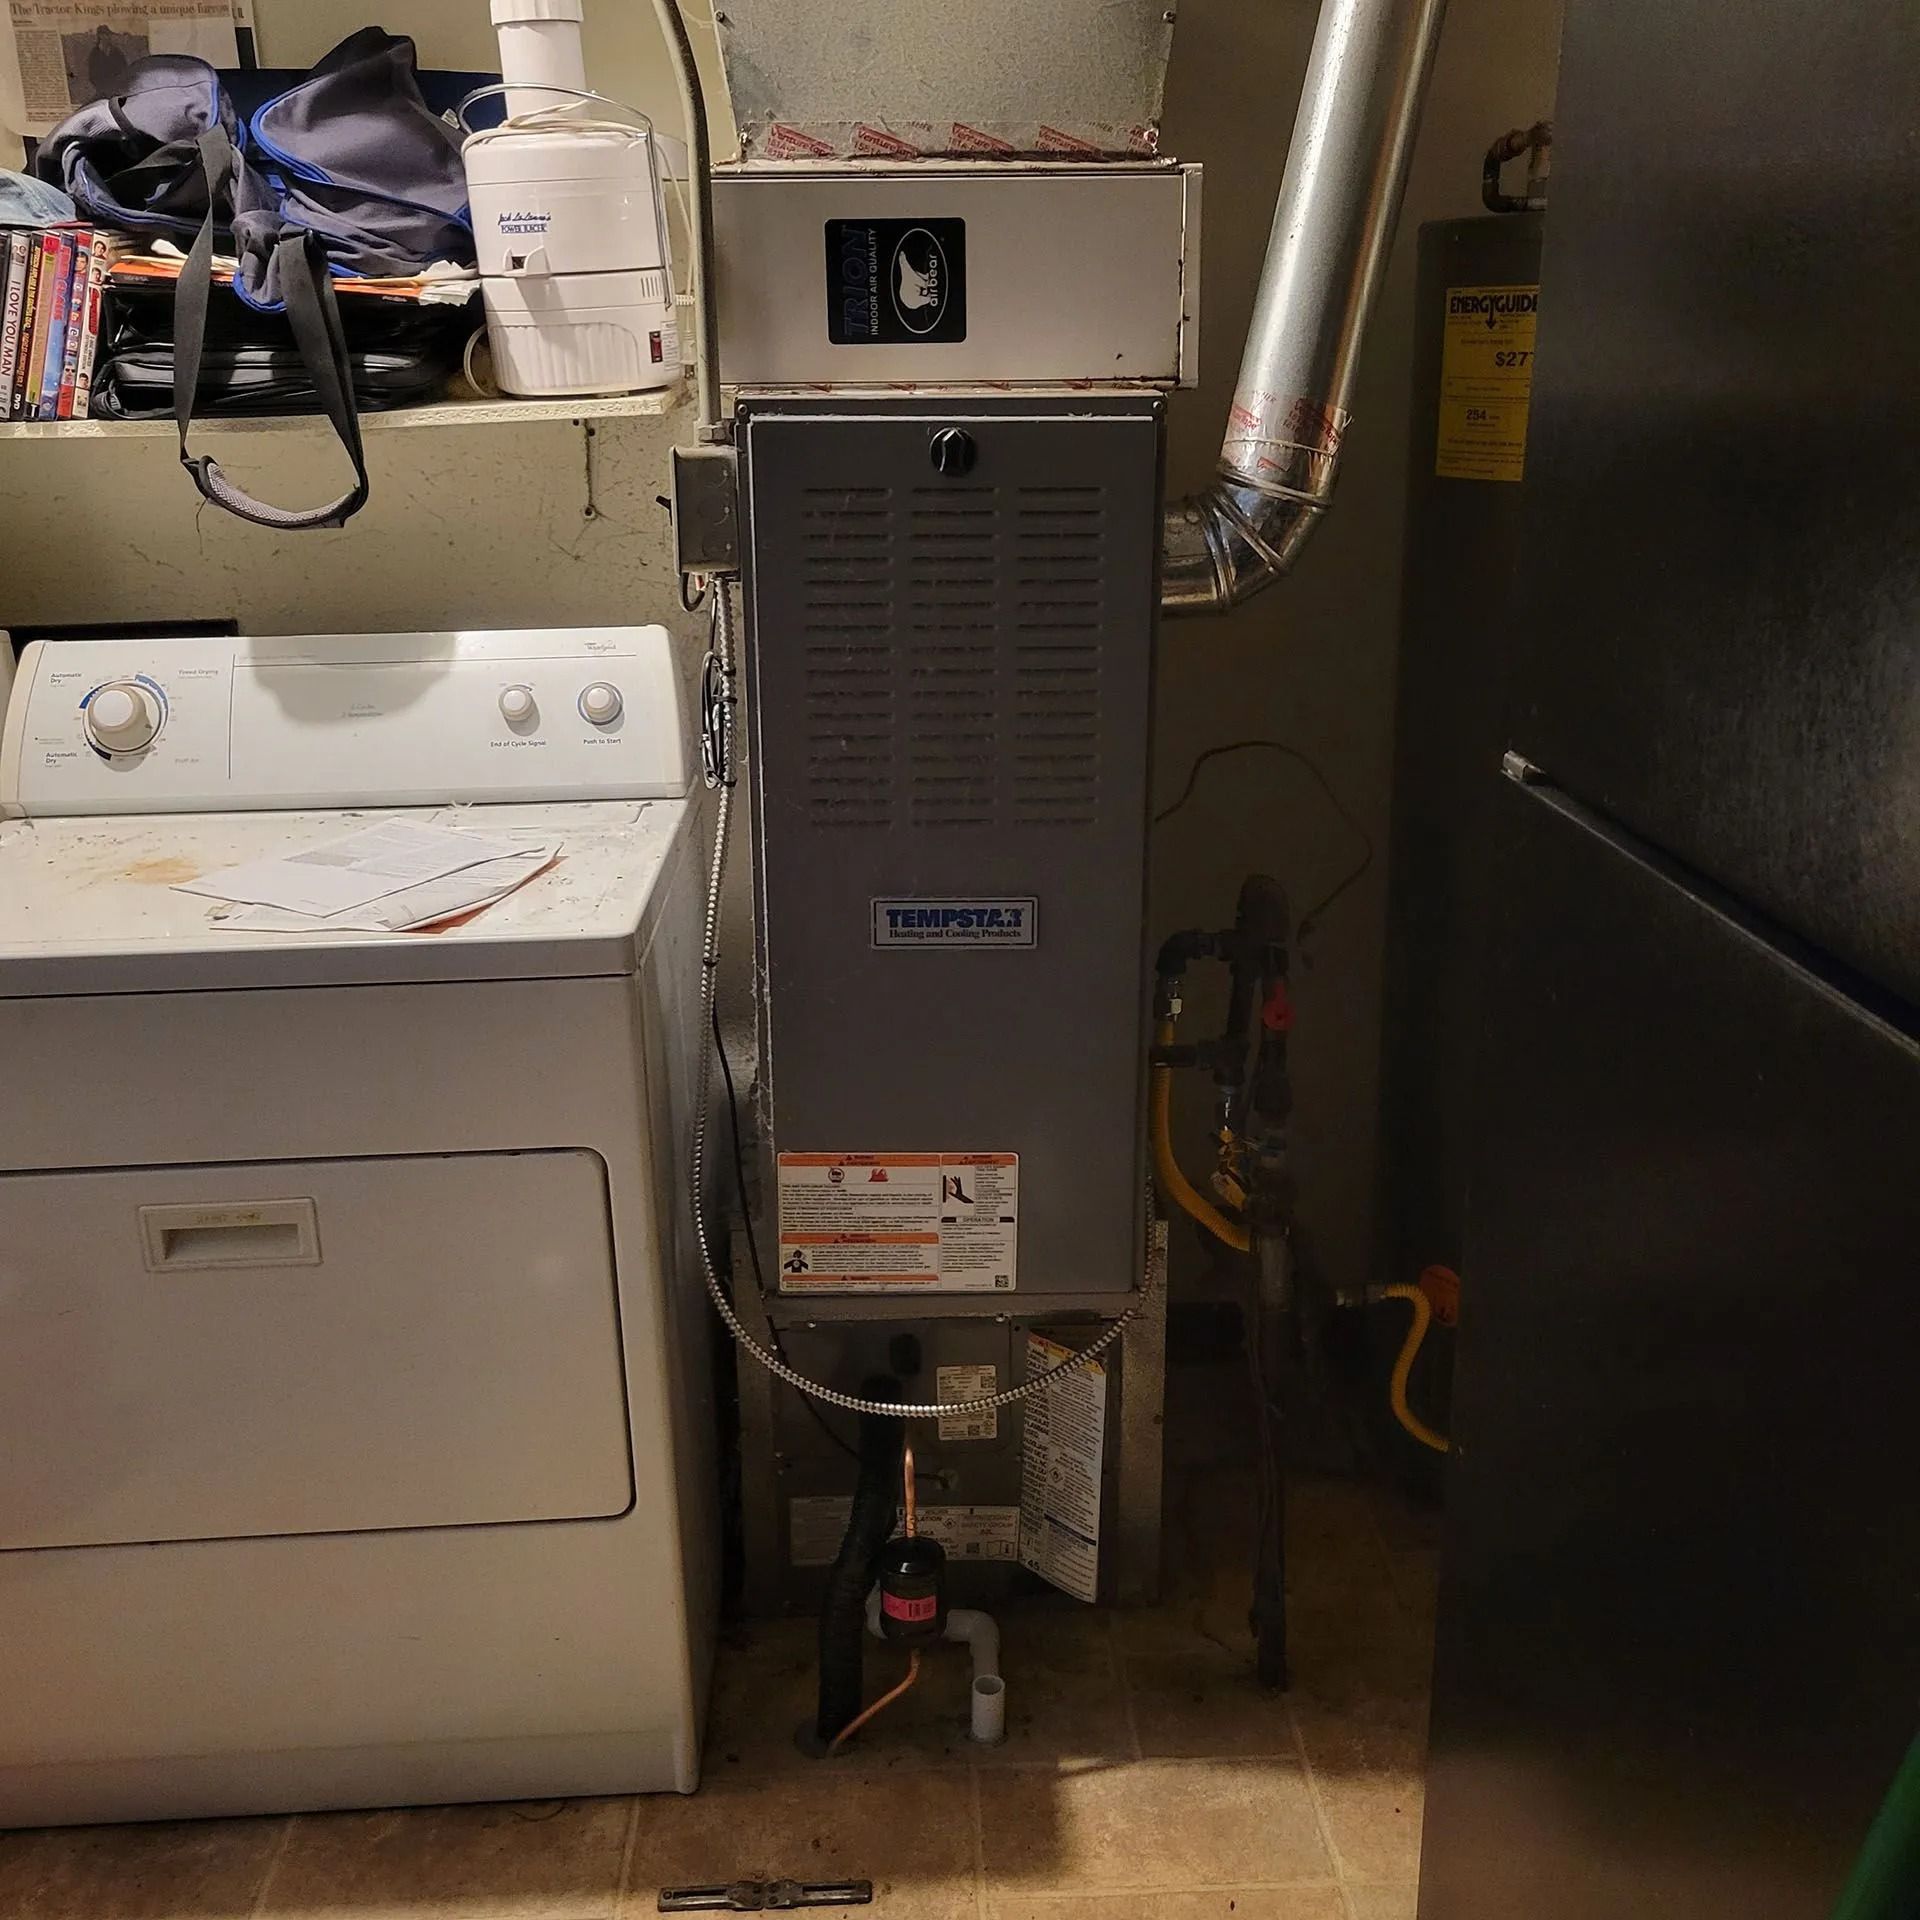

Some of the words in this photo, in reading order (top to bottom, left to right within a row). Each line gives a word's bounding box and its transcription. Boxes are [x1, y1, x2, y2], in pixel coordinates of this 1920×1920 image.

[10, 3, 32, 16] The
[34, 3, 73, 16] Tractor
[75, 3, 105, 17] Kings
[106, 3, 149, 17] plowing
[150, 6, 158, 15] a
[159, 4, 195, 17] unique
[770, 127, 810, 151] Venture
[856, 129, 896, 152] Venture
[951, 126, 990, 150] Venture
[1038, 128, 1078, 152] Venture
[500, 224, 522, 235] POWER
[867, 228, 879, 275] QUALITY
[841, 224, 869, 336] TRION
[868, 276, 880, 295] AIR
[7, 285, 21, 318] LOVE
[869, 295, 880, 336] INDOOR
[2, 318, 18, 347] YOU
[0, 347, 15, 377] MAN
[13, 393, 23, 411] DVD
[1466, 408, 1487, 420] 254
[198, 669, 220, 677] Drying
[490, 740, 503, 748] End
[511, 740, 528, 749] Cycle
[528, 740, 548, 749] Signal
[583, 738, 599, 746] Push
[606, 737, 623, 745] Start
[886, 908, 1023, 928] TEMPSTAR
[889, 929, 925, 940] Heating
[925, 928, 944, 939] and
[945, 928, 981, 940] Cooling
[981, 928, 1023, 939] Products
